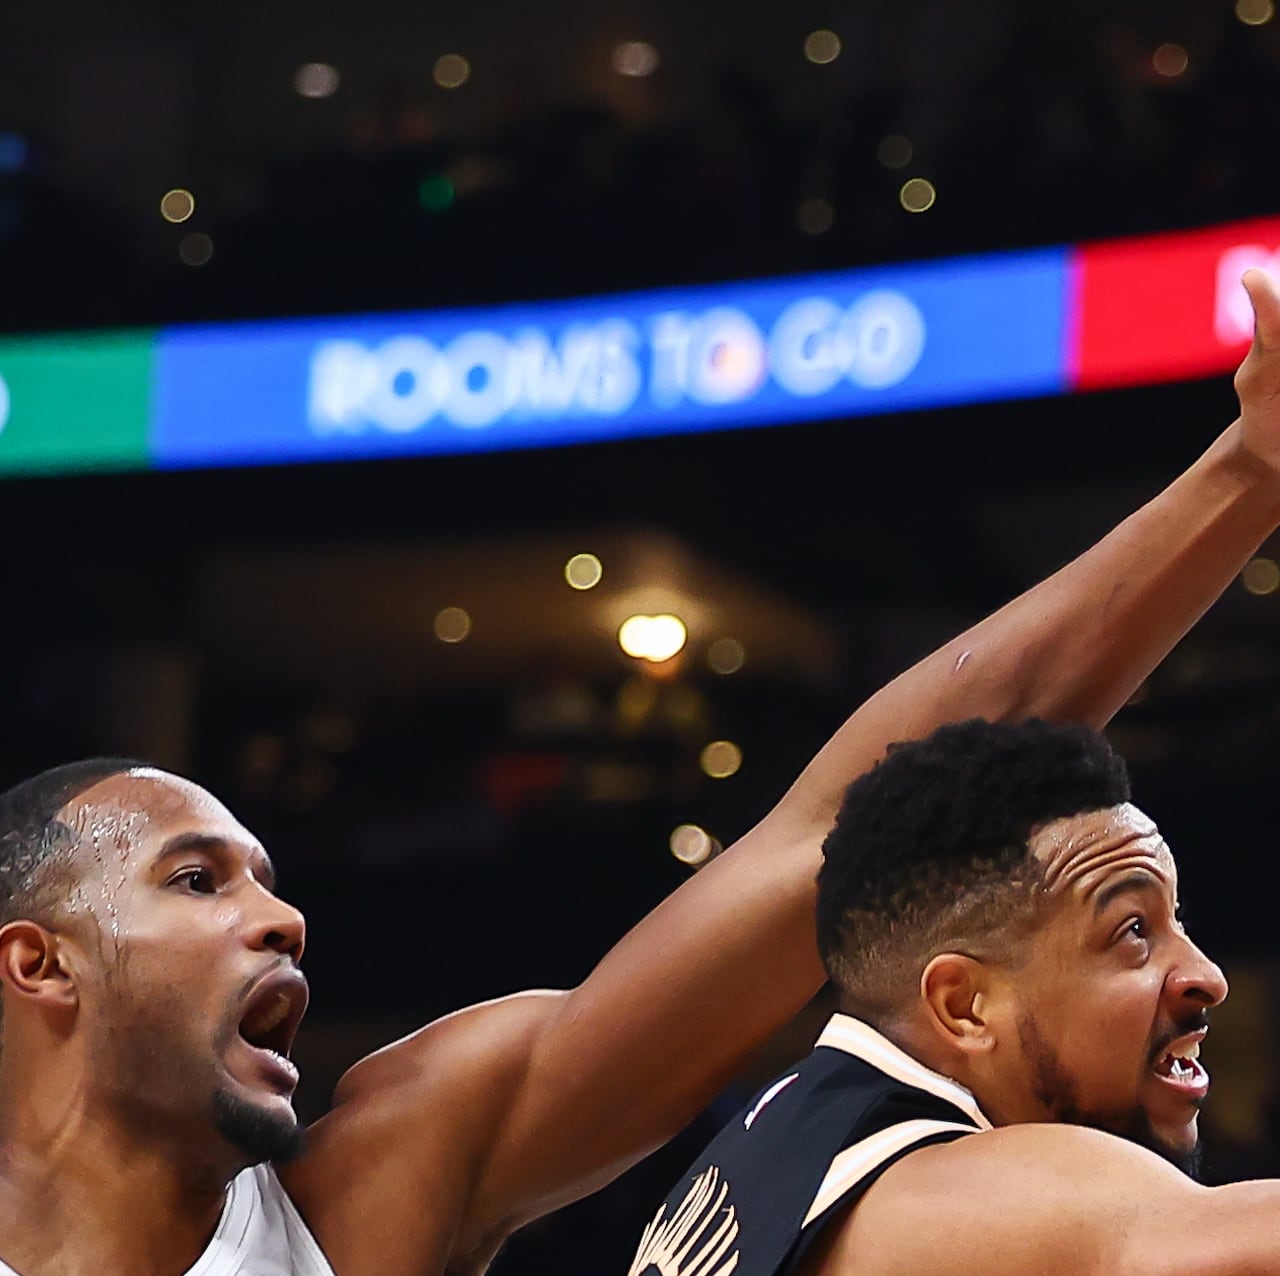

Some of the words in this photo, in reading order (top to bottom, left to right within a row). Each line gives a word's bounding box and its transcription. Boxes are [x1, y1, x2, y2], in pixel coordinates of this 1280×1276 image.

[306, 318, 641, 435] ROOMS
[648, 304, 766, 410] TO
[769, 289, 926, 396] GO
